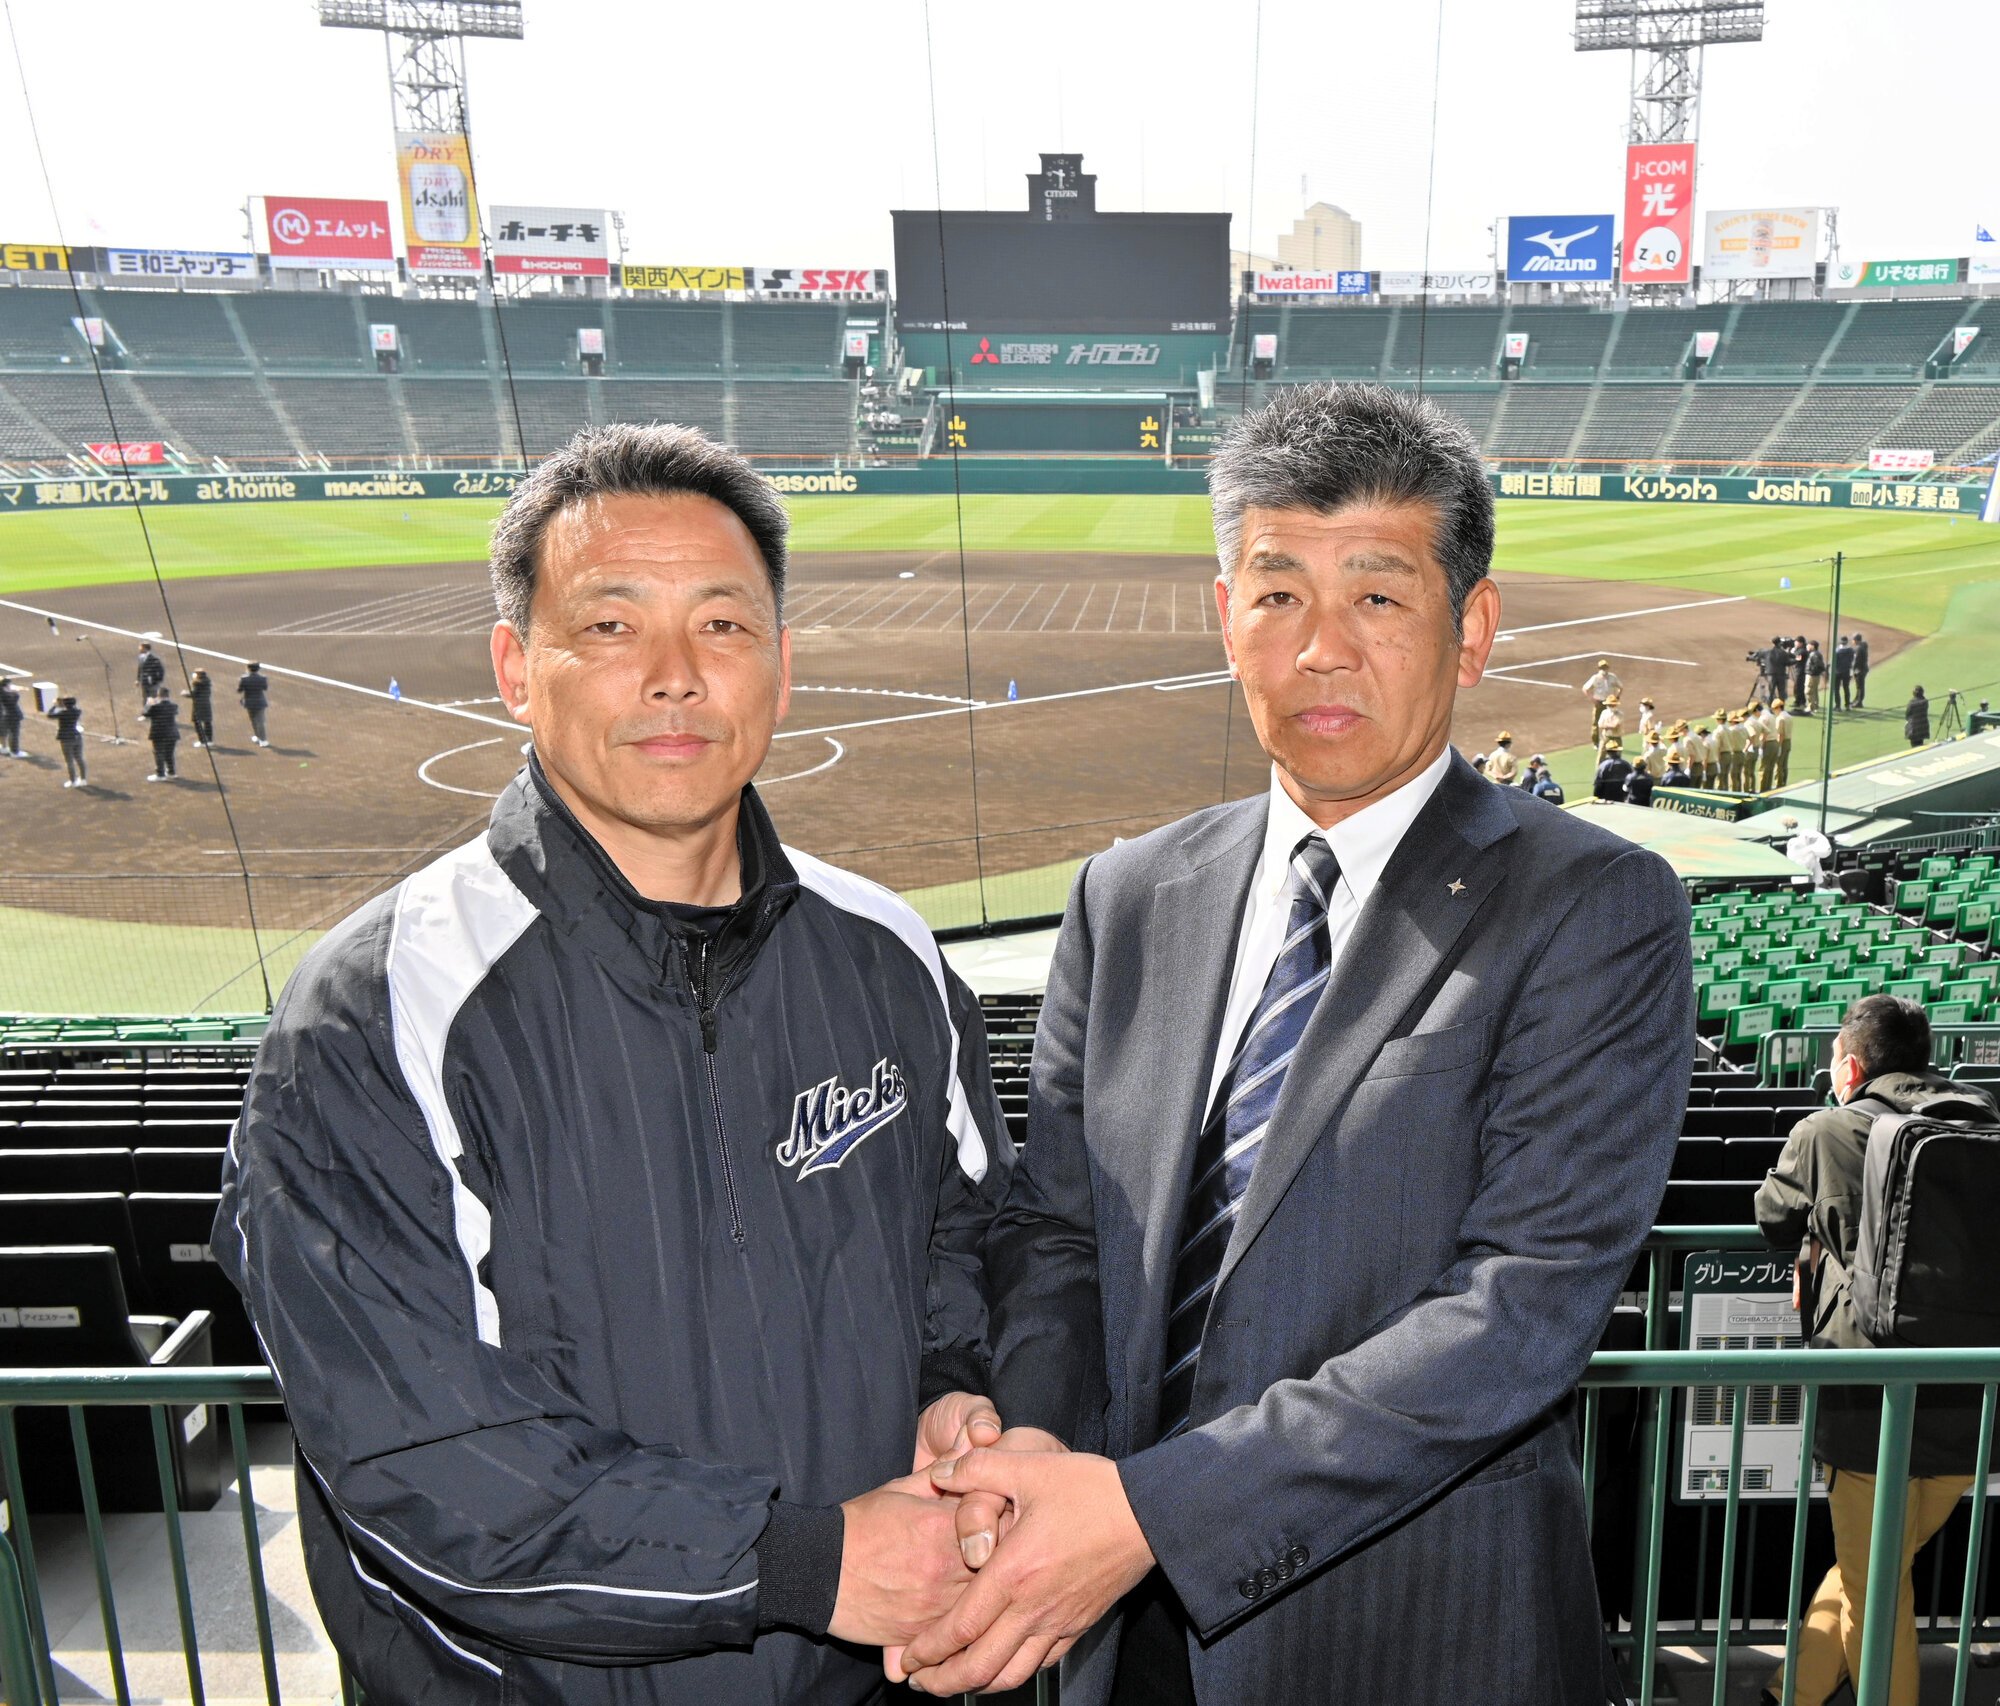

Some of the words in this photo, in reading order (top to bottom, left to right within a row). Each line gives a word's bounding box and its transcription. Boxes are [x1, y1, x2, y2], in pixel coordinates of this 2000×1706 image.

[1632, 160, 1687, 181] J:COM
[415, 189, 465, 207] Asahi
[1044, 189, 1078, 198] CITIZEN
[1641, 182, 1678, 217] 光
[314, 219, 386, 239] エムット
[499, 221, 600, 243] ホーチキ
[0, 244, 73, 271] ETT
[118, 253, 247, 275] 三和シャッター
[624, 266, 744, 288] 関西ペイント
[799, 269, 871, 290] SSK
[1258, 273, 1334, 290] Iwatani
[1340, 272, 1366, 287] 水素
[1875, 263, 1951, 282] りそな銀行
[1001, 343, 1059, 354] MITSUBISHI
[1001, 354, 1052, 364] ELECTRIC
[1140, 416, 1159, 448] 山九
[35, 479, 169, 504] 東進ハイスクール
[197, 480, 224, 500] at
[226, 477, 296, 498] home
[1500, 474, 1601, 497] 朝日新聞
[1624, 476, 1718, 500] Kubota
[1748, 478, 1831, 503] Joshin
[1873, 484, 1960, 510] 小野薬品
